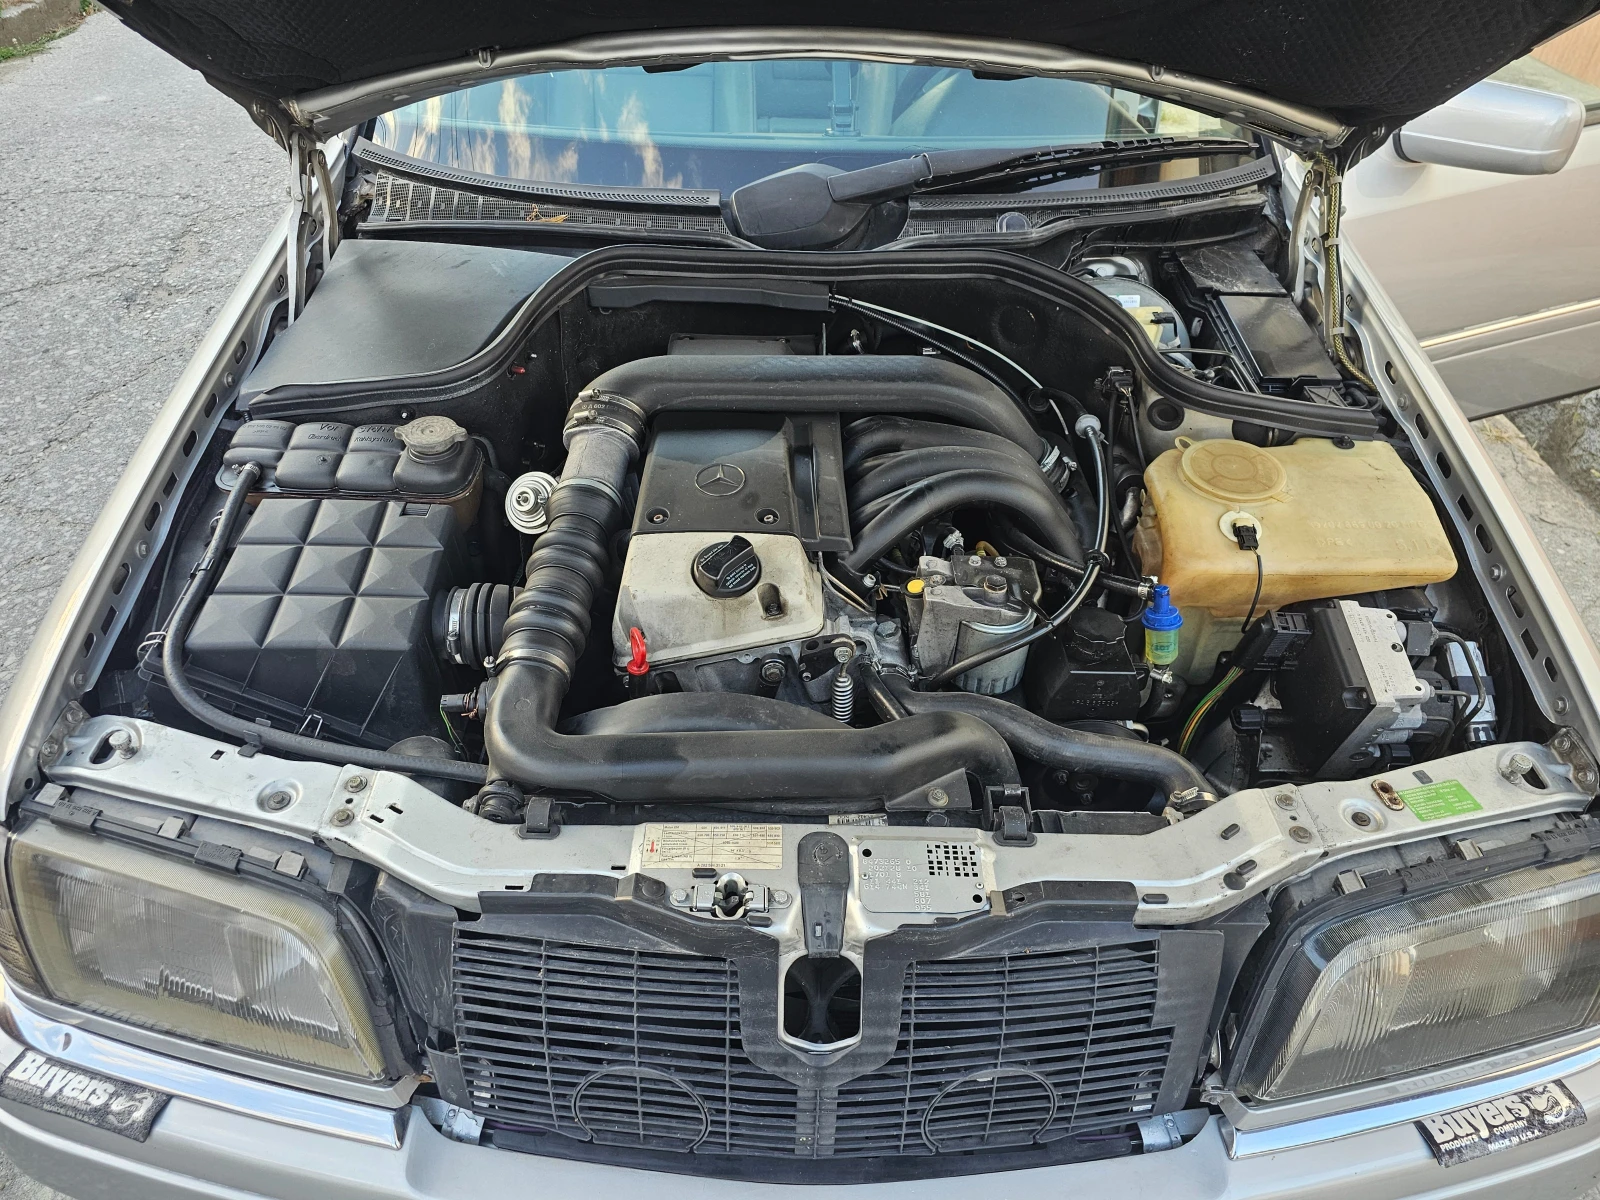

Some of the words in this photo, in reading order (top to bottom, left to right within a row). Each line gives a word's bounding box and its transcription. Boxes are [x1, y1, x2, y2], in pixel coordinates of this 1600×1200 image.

[4, 1078, 42, 1096] PRODUCTS
[8, 1052, 116, 1106] Buyers
[1422, 1095, 1530, 1144] Buyers
[1440, 1134, 1478, 1152] PRODUCTS
[1493, 1120, 1528, 1135] COMPANY
[1488, 1138, 1510, 1152] MADE
[1510, 1136, 1520, 1145] IN
[1520, 1130, 1543, 1142] U.S.A.
